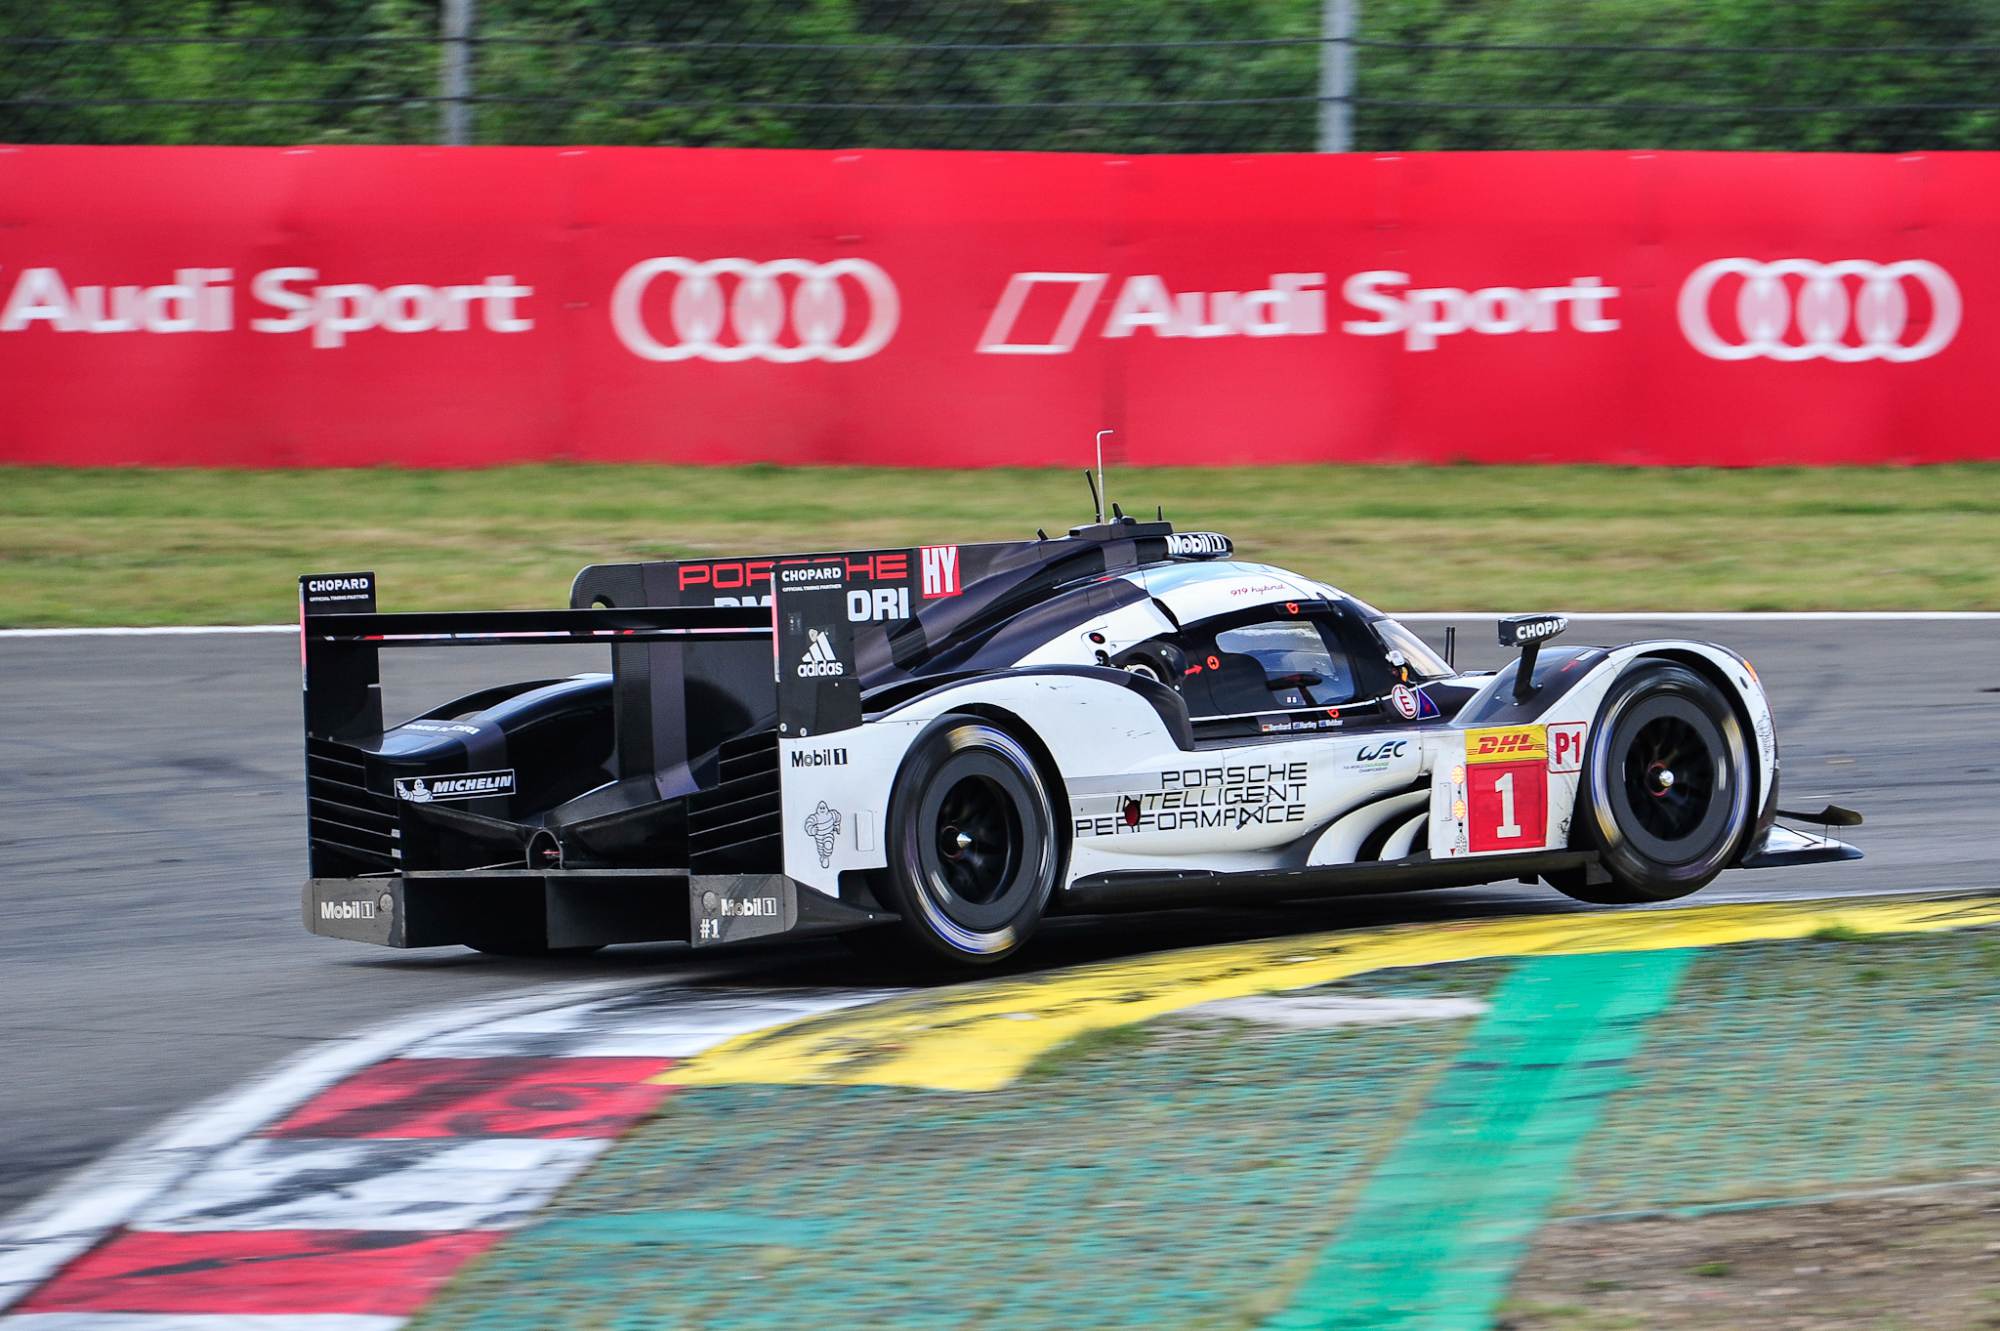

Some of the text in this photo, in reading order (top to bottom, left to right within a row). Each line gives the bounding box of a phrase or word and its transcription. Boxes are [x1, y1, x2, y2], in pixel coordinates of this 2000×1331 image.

[1, 266, 534, 349] Audi Sport
[1101, 269, 1621, 352] Audi Sport
[1164, 534, 1211, 554] Mobil
[679, 553, 908, 591] PORHE
[781, 567, 842, 582] CHOPARD
[921, 546, 957, 595] HY
[308, 577, 369, 592] CHOPARD
[1231, 587, 1248, 597] 919
[797, 660, 844, 677] adidas
[1398, 695, 1414, 713] E
[1356, 740, 1408, 761] WEC
[1478, 733, 1535, 755] DHL
[1555, 731, 1581, 765] P1
[791, 749, 831, 767] Mobil
[432, 775, 512, 793] MICHELIN
[1161, 762, 1307, 789] PORSCHE
[1116, 783, 1307, 812] INTELLIGENT
[1495, 772, 1522, 839] 1
[1075, 804, 1306, 838] PERFORMANCE
[321, 901, 360, 919] Mobil
[720, 897, 761, 916] Mobil
[700, 918, 720, 939] #1
